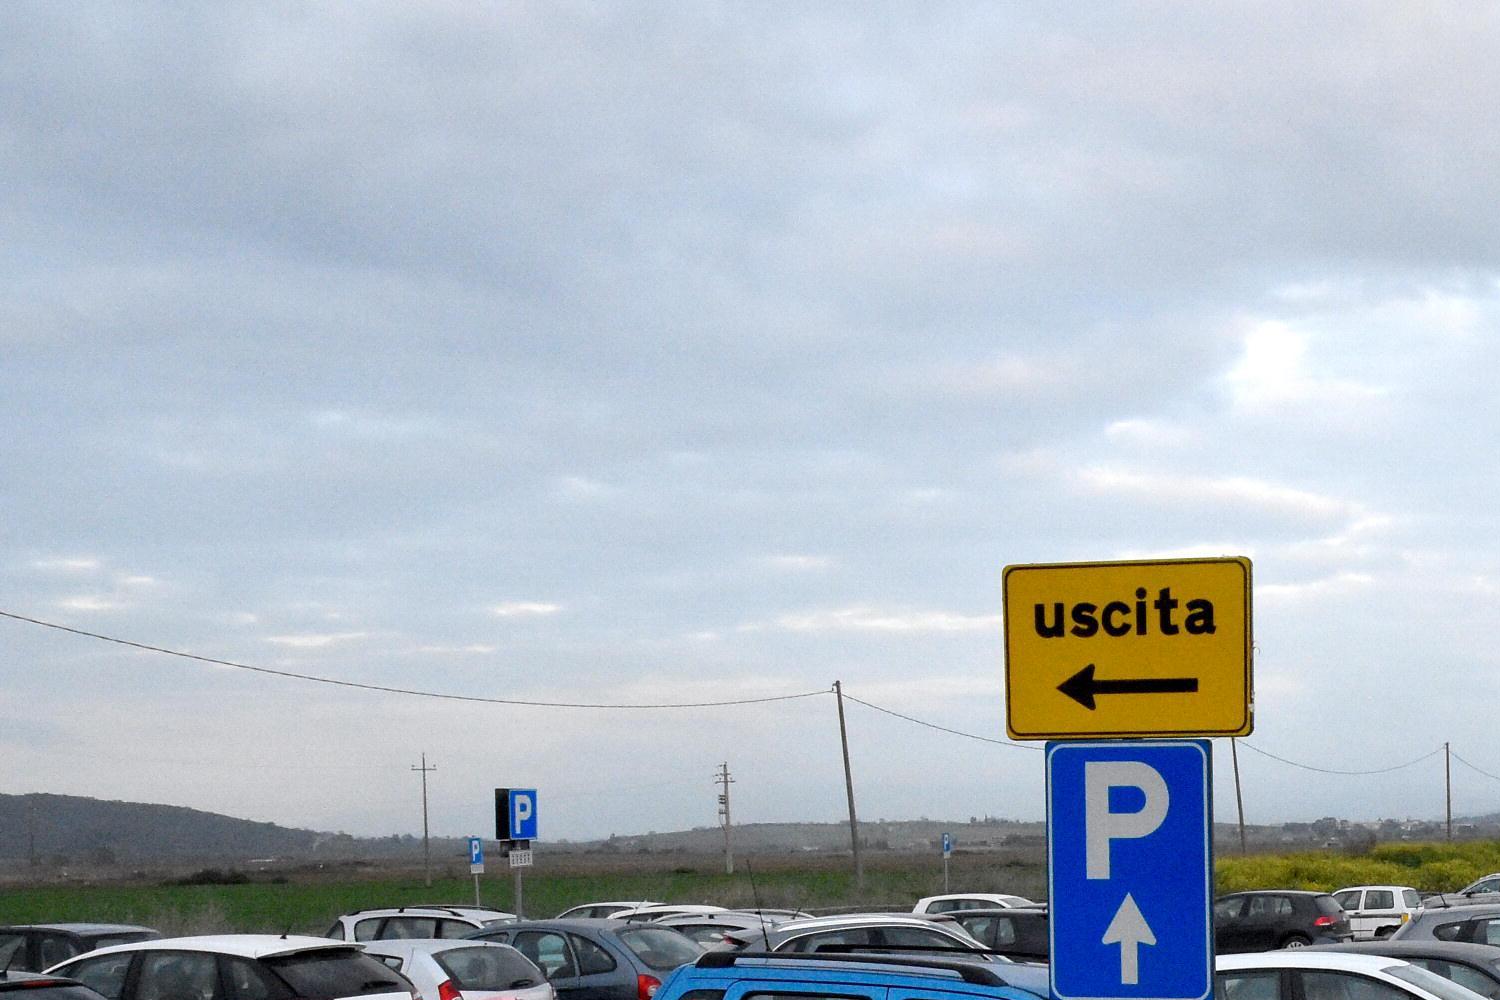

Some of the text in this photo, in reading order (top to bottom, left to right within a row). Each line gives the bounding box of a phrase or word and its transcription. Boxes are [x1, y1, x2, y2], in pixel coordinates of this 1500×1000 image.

[1034, 587, 1217, 639] uscita
[514, 794, 532, 834] P
[1085, 761, 1170, 880] P
[471, 840, 480, 862] P
